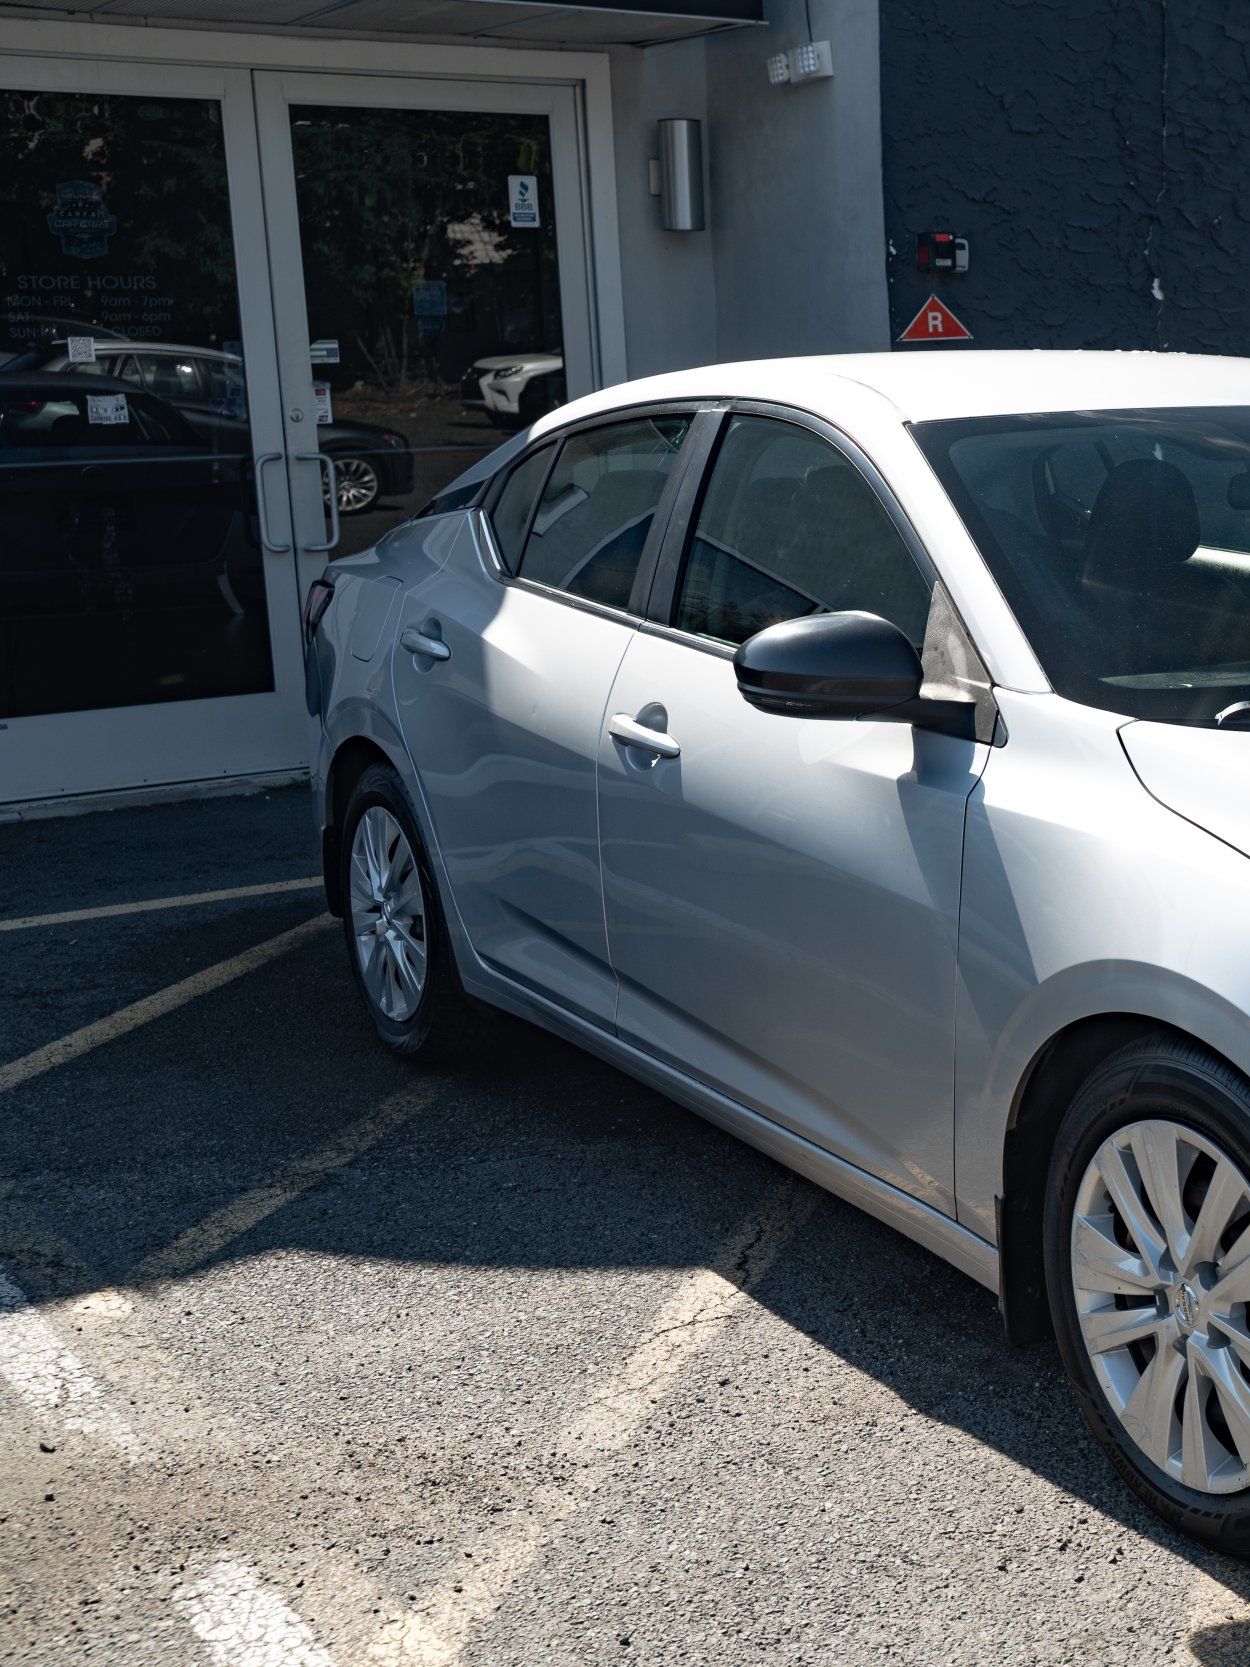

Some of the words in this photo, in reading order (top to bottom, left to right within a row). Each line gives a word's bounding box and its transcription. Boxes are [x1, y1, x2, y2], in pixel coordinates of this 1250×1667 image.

[514, 203, 533, 211] BBB
[17, 275, 81, 289] STORE
[88, 275, 157, 289] HOURS
[7, 295, 42, 307] MON
[101, 295, 130, 307] 9am
[101, 311, 130, 321] 9am
[142, 311, 171, 323] 6pm
[927, 311, 943, 332] R
[111, 325, 162, 337] CLOSED
